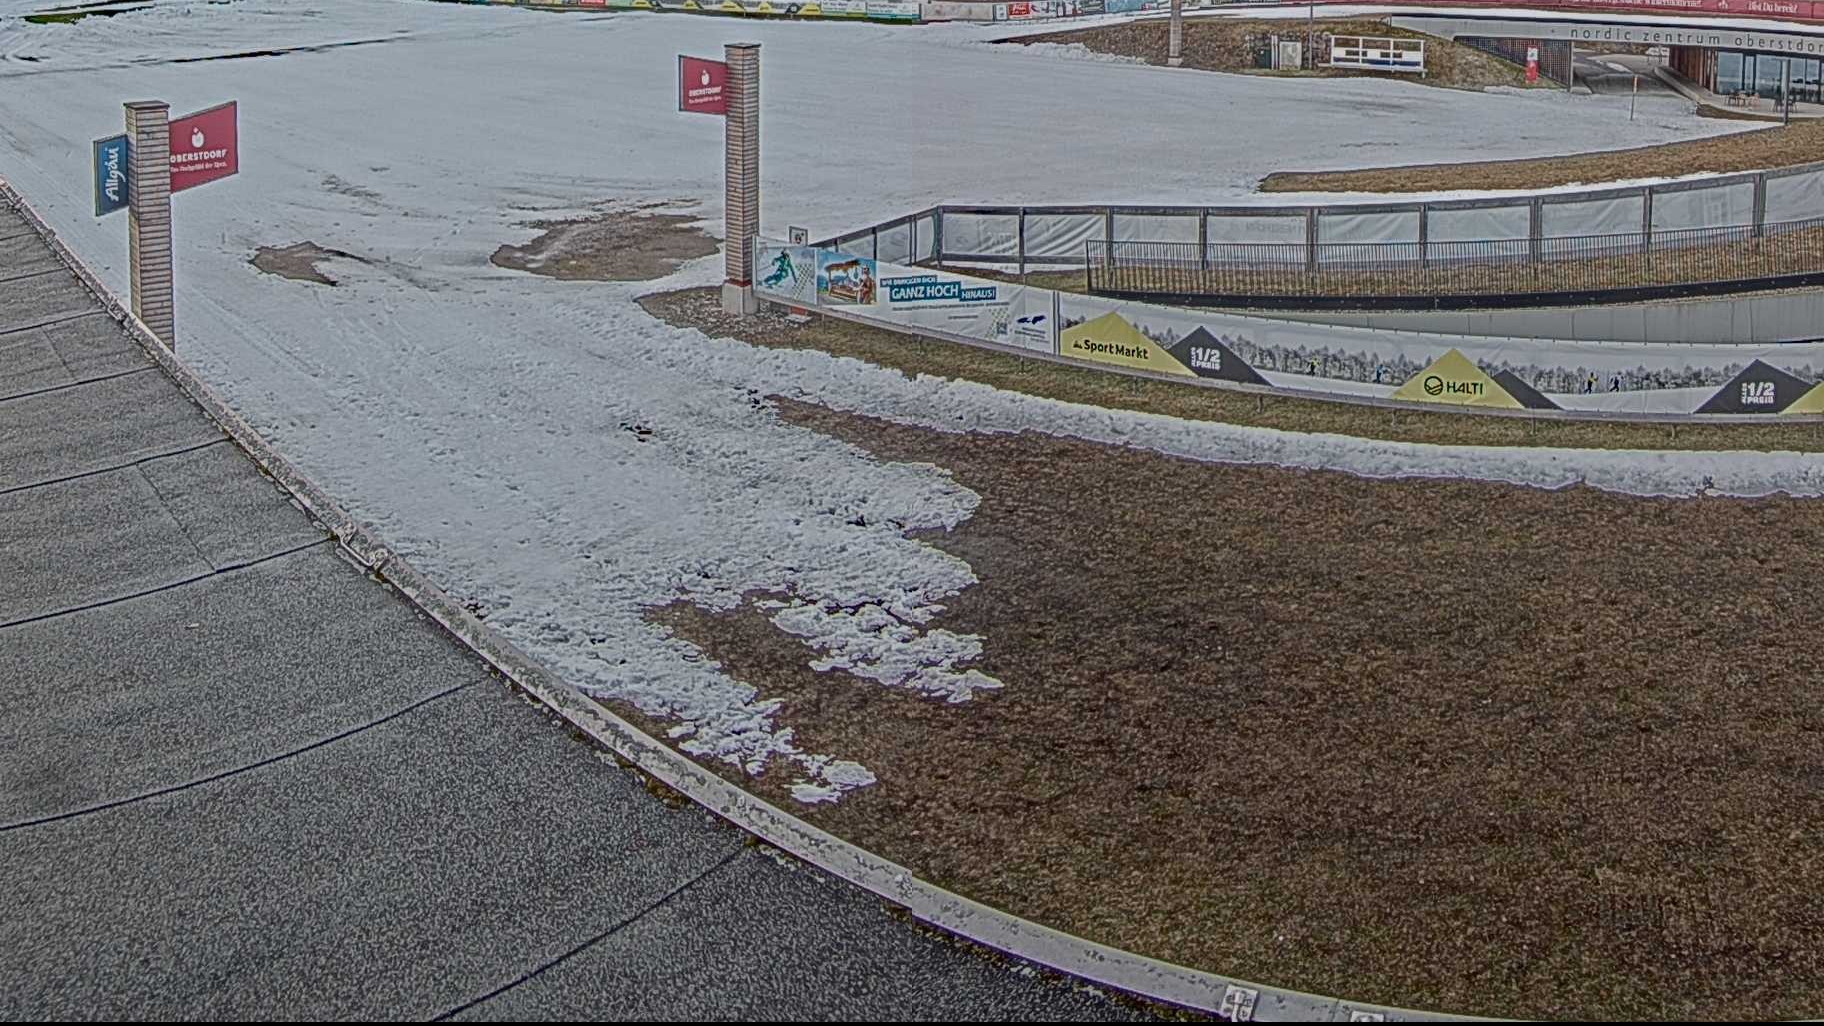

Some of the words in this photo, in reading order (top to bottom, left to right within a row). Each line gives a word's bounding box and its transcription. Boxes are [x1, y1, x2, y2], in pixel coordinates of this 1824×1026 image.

[1570, 27, 1631, 41] nordic
[1643, 32, 1720, 45] zentrum
[169, 148, 227, 163] OBERSTDORF
[105, 146, 126, 202] Allgäu
[926, 284, 959, 298] HOCH
[1196, 347, 1221, 362] 1/2
[1446, 381, 1484, 396] HALTI
[1749, 382, 1776, 397] 1/2
